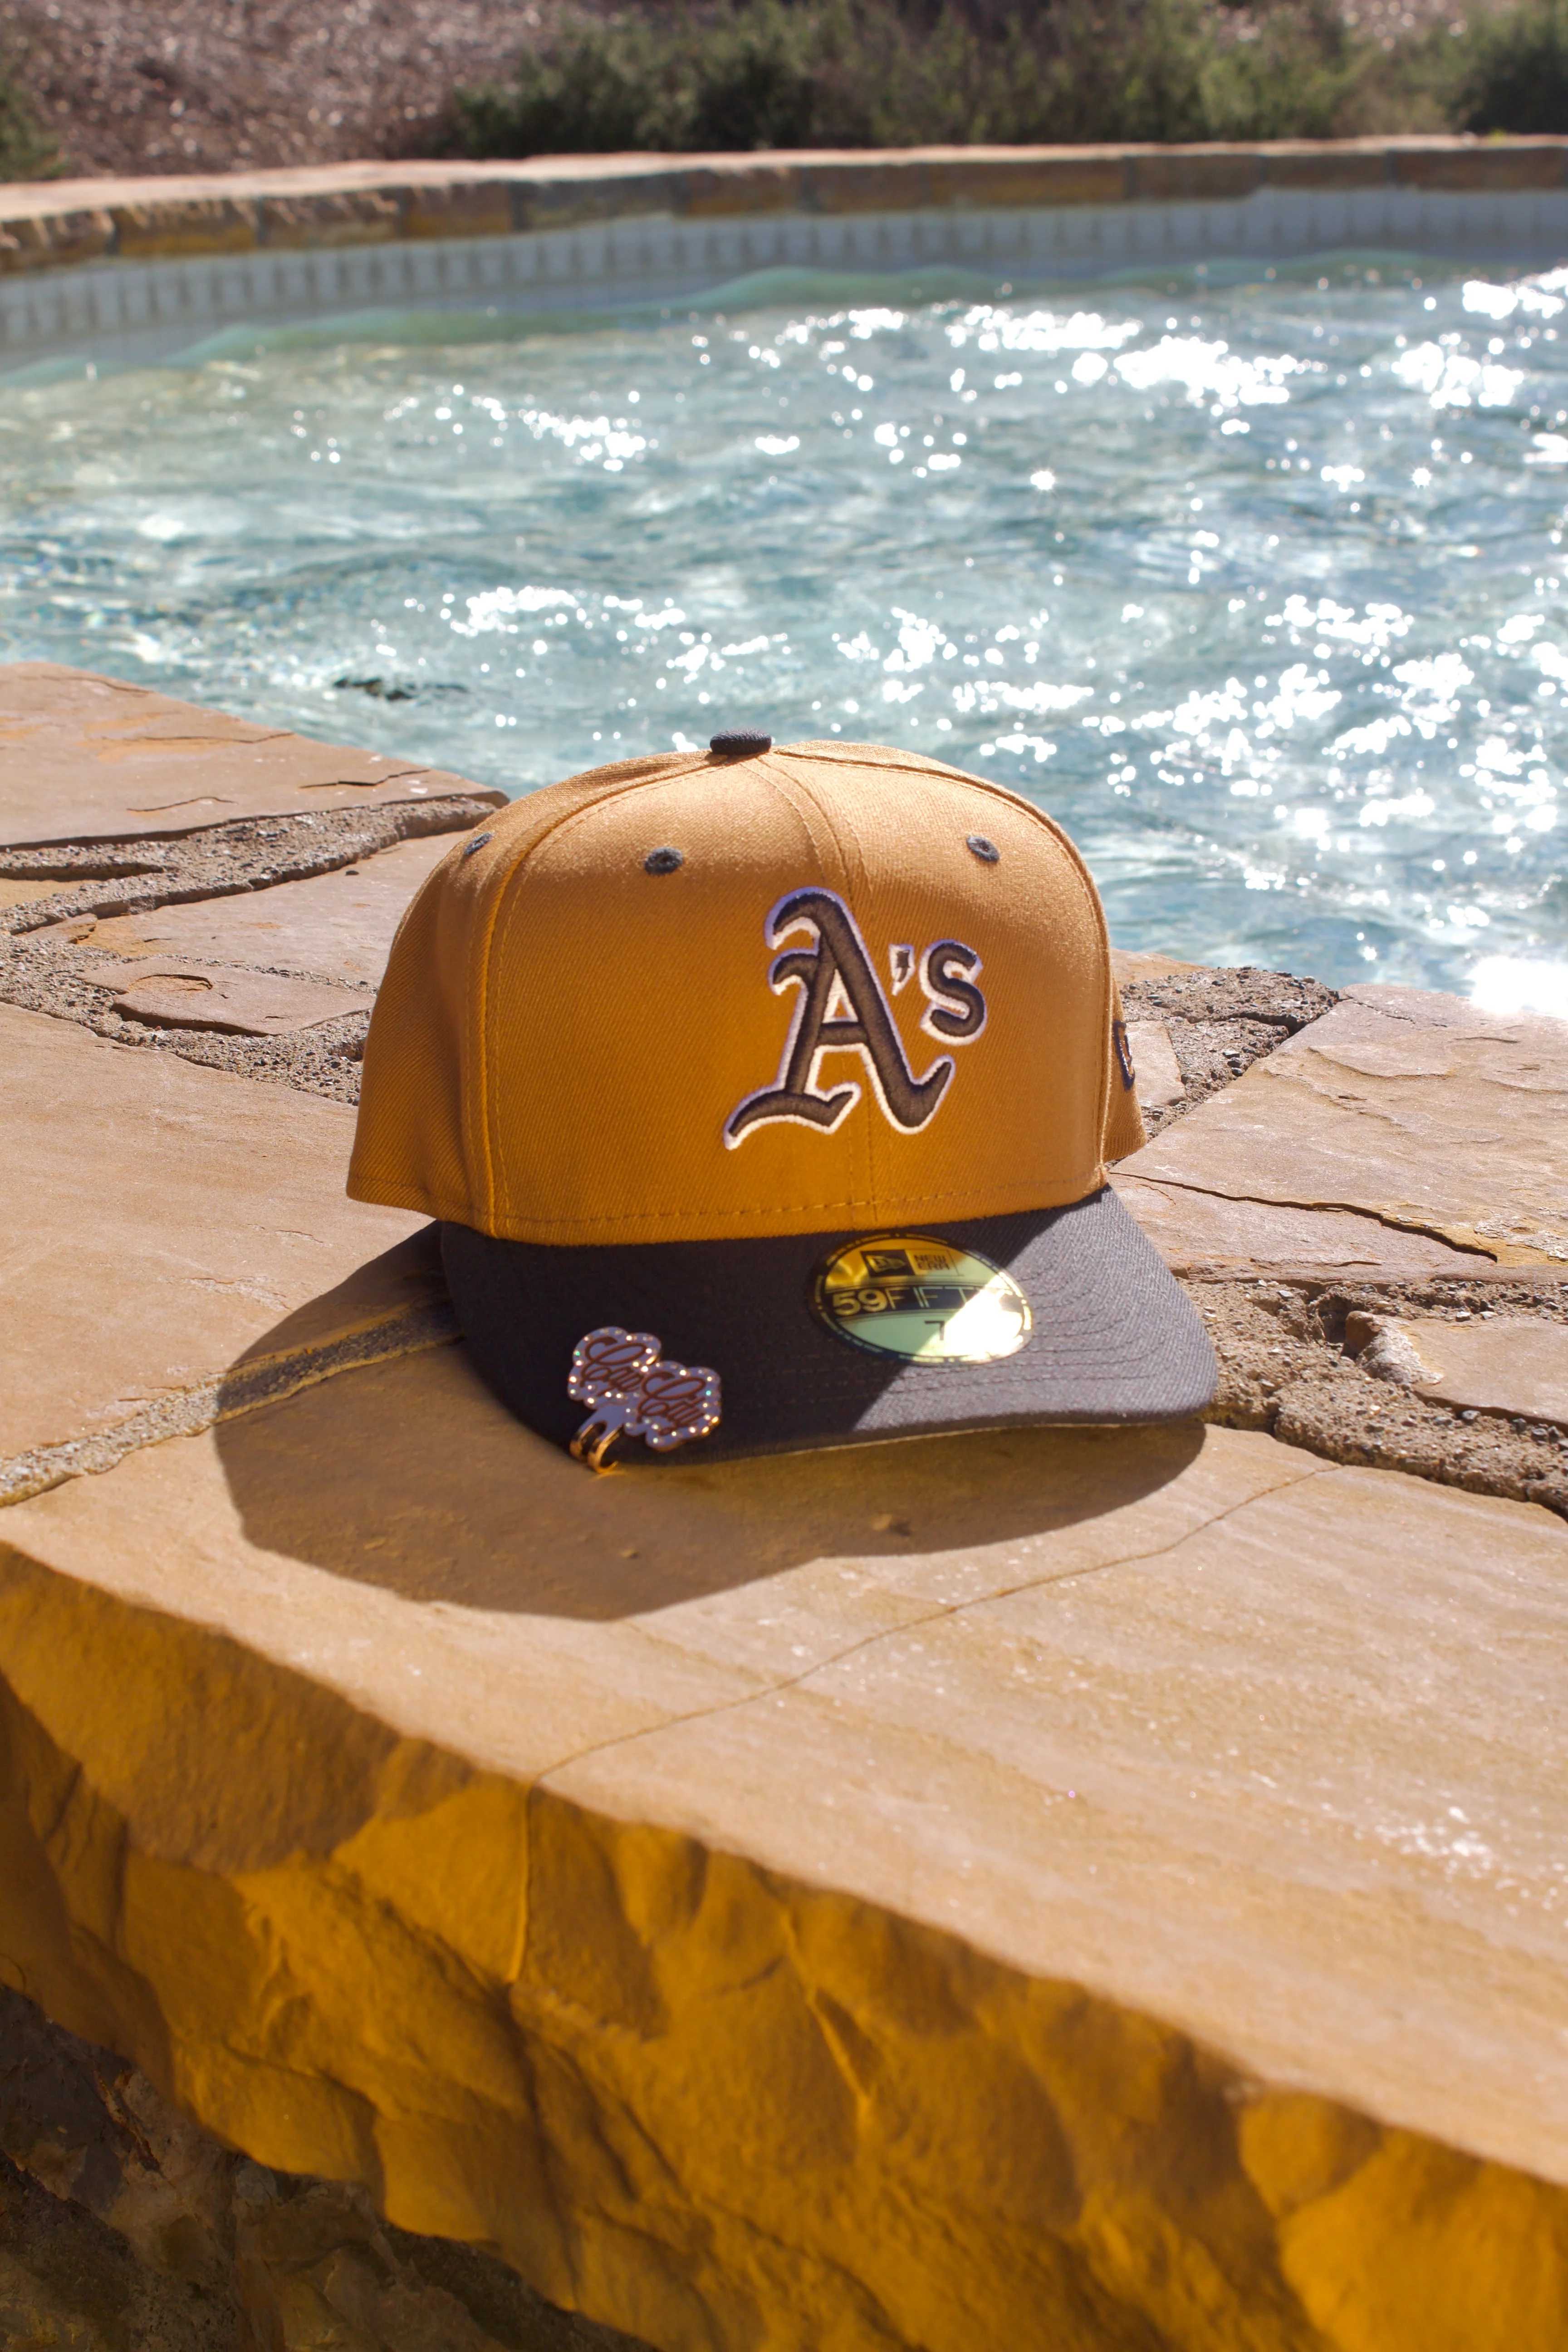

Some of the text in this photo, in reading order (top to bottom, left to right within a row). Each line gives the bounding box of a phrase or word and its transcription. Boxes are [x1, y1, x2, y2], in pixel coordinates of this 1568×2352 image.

[723, 886, 988, 1151] A's
[914, 1254, 947, 1263] NEW
[917, 1261, 950, 1270] ERA
